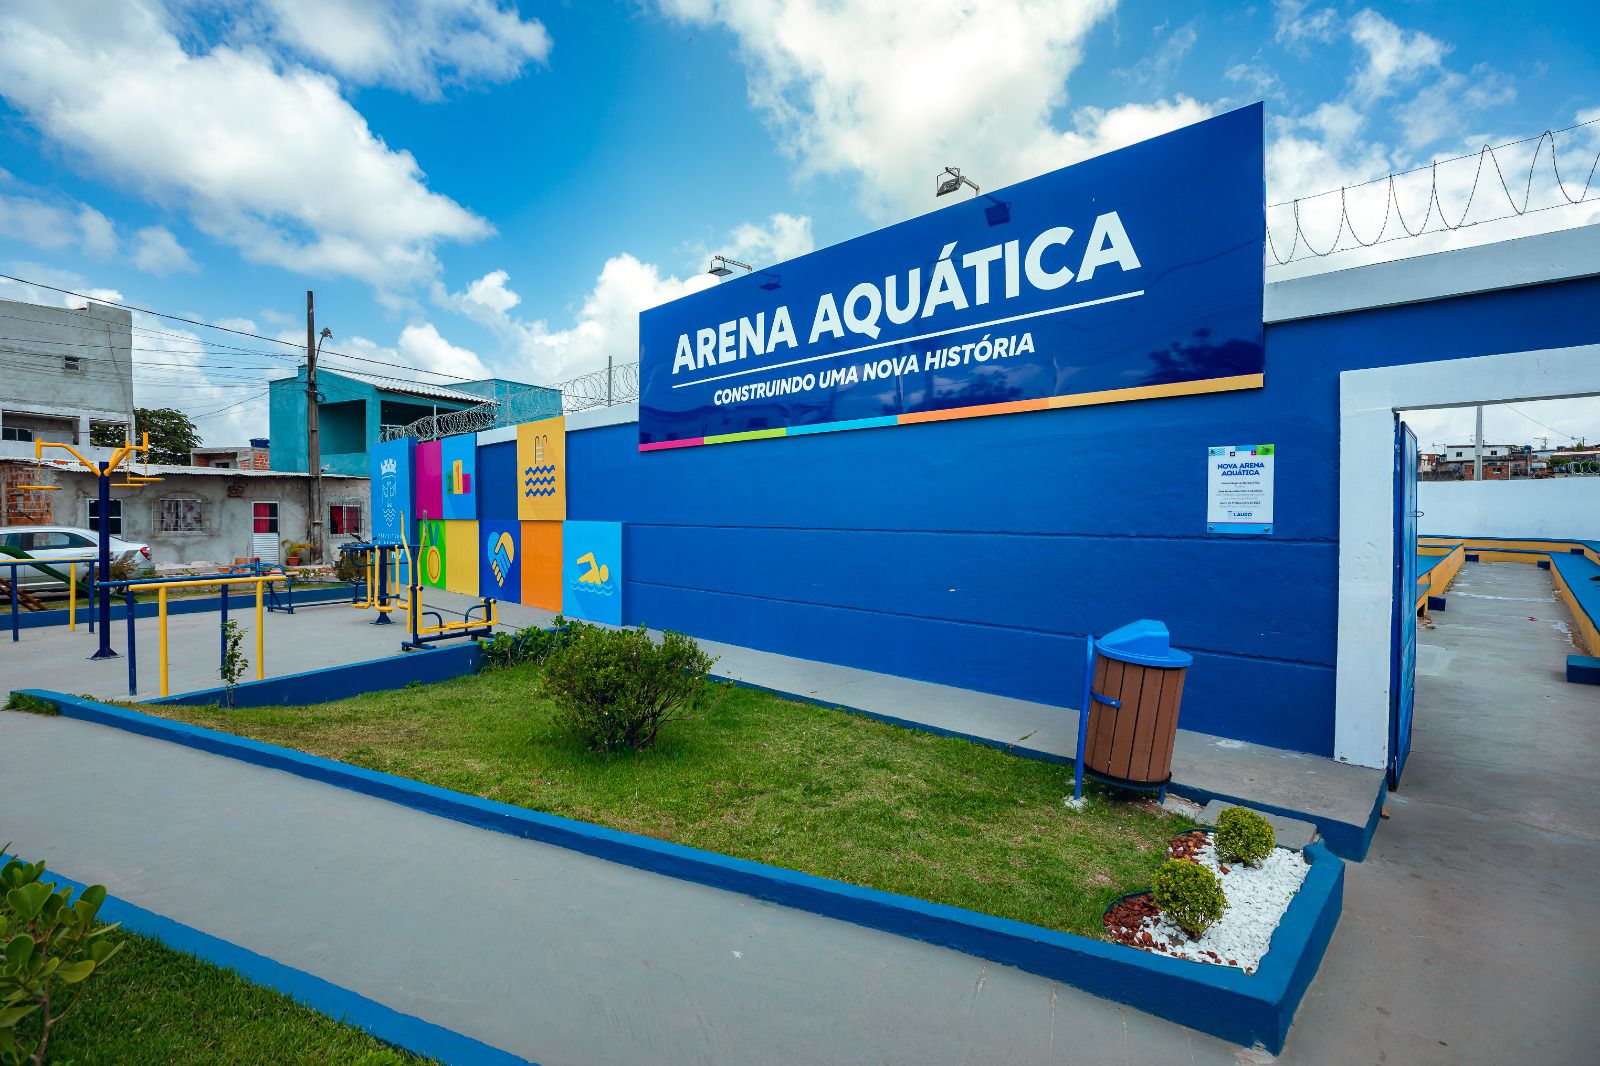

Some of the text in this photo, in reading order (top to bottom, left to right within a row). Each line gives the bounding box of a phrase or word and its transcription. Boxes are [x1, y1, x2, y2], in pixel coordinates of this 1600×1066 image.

[672, 211, 1141, 375] ARENA AQUÁTICA
[714, 332, 1035, 406] CONSTRUINDO UMA NOVA HISTÓRIA
